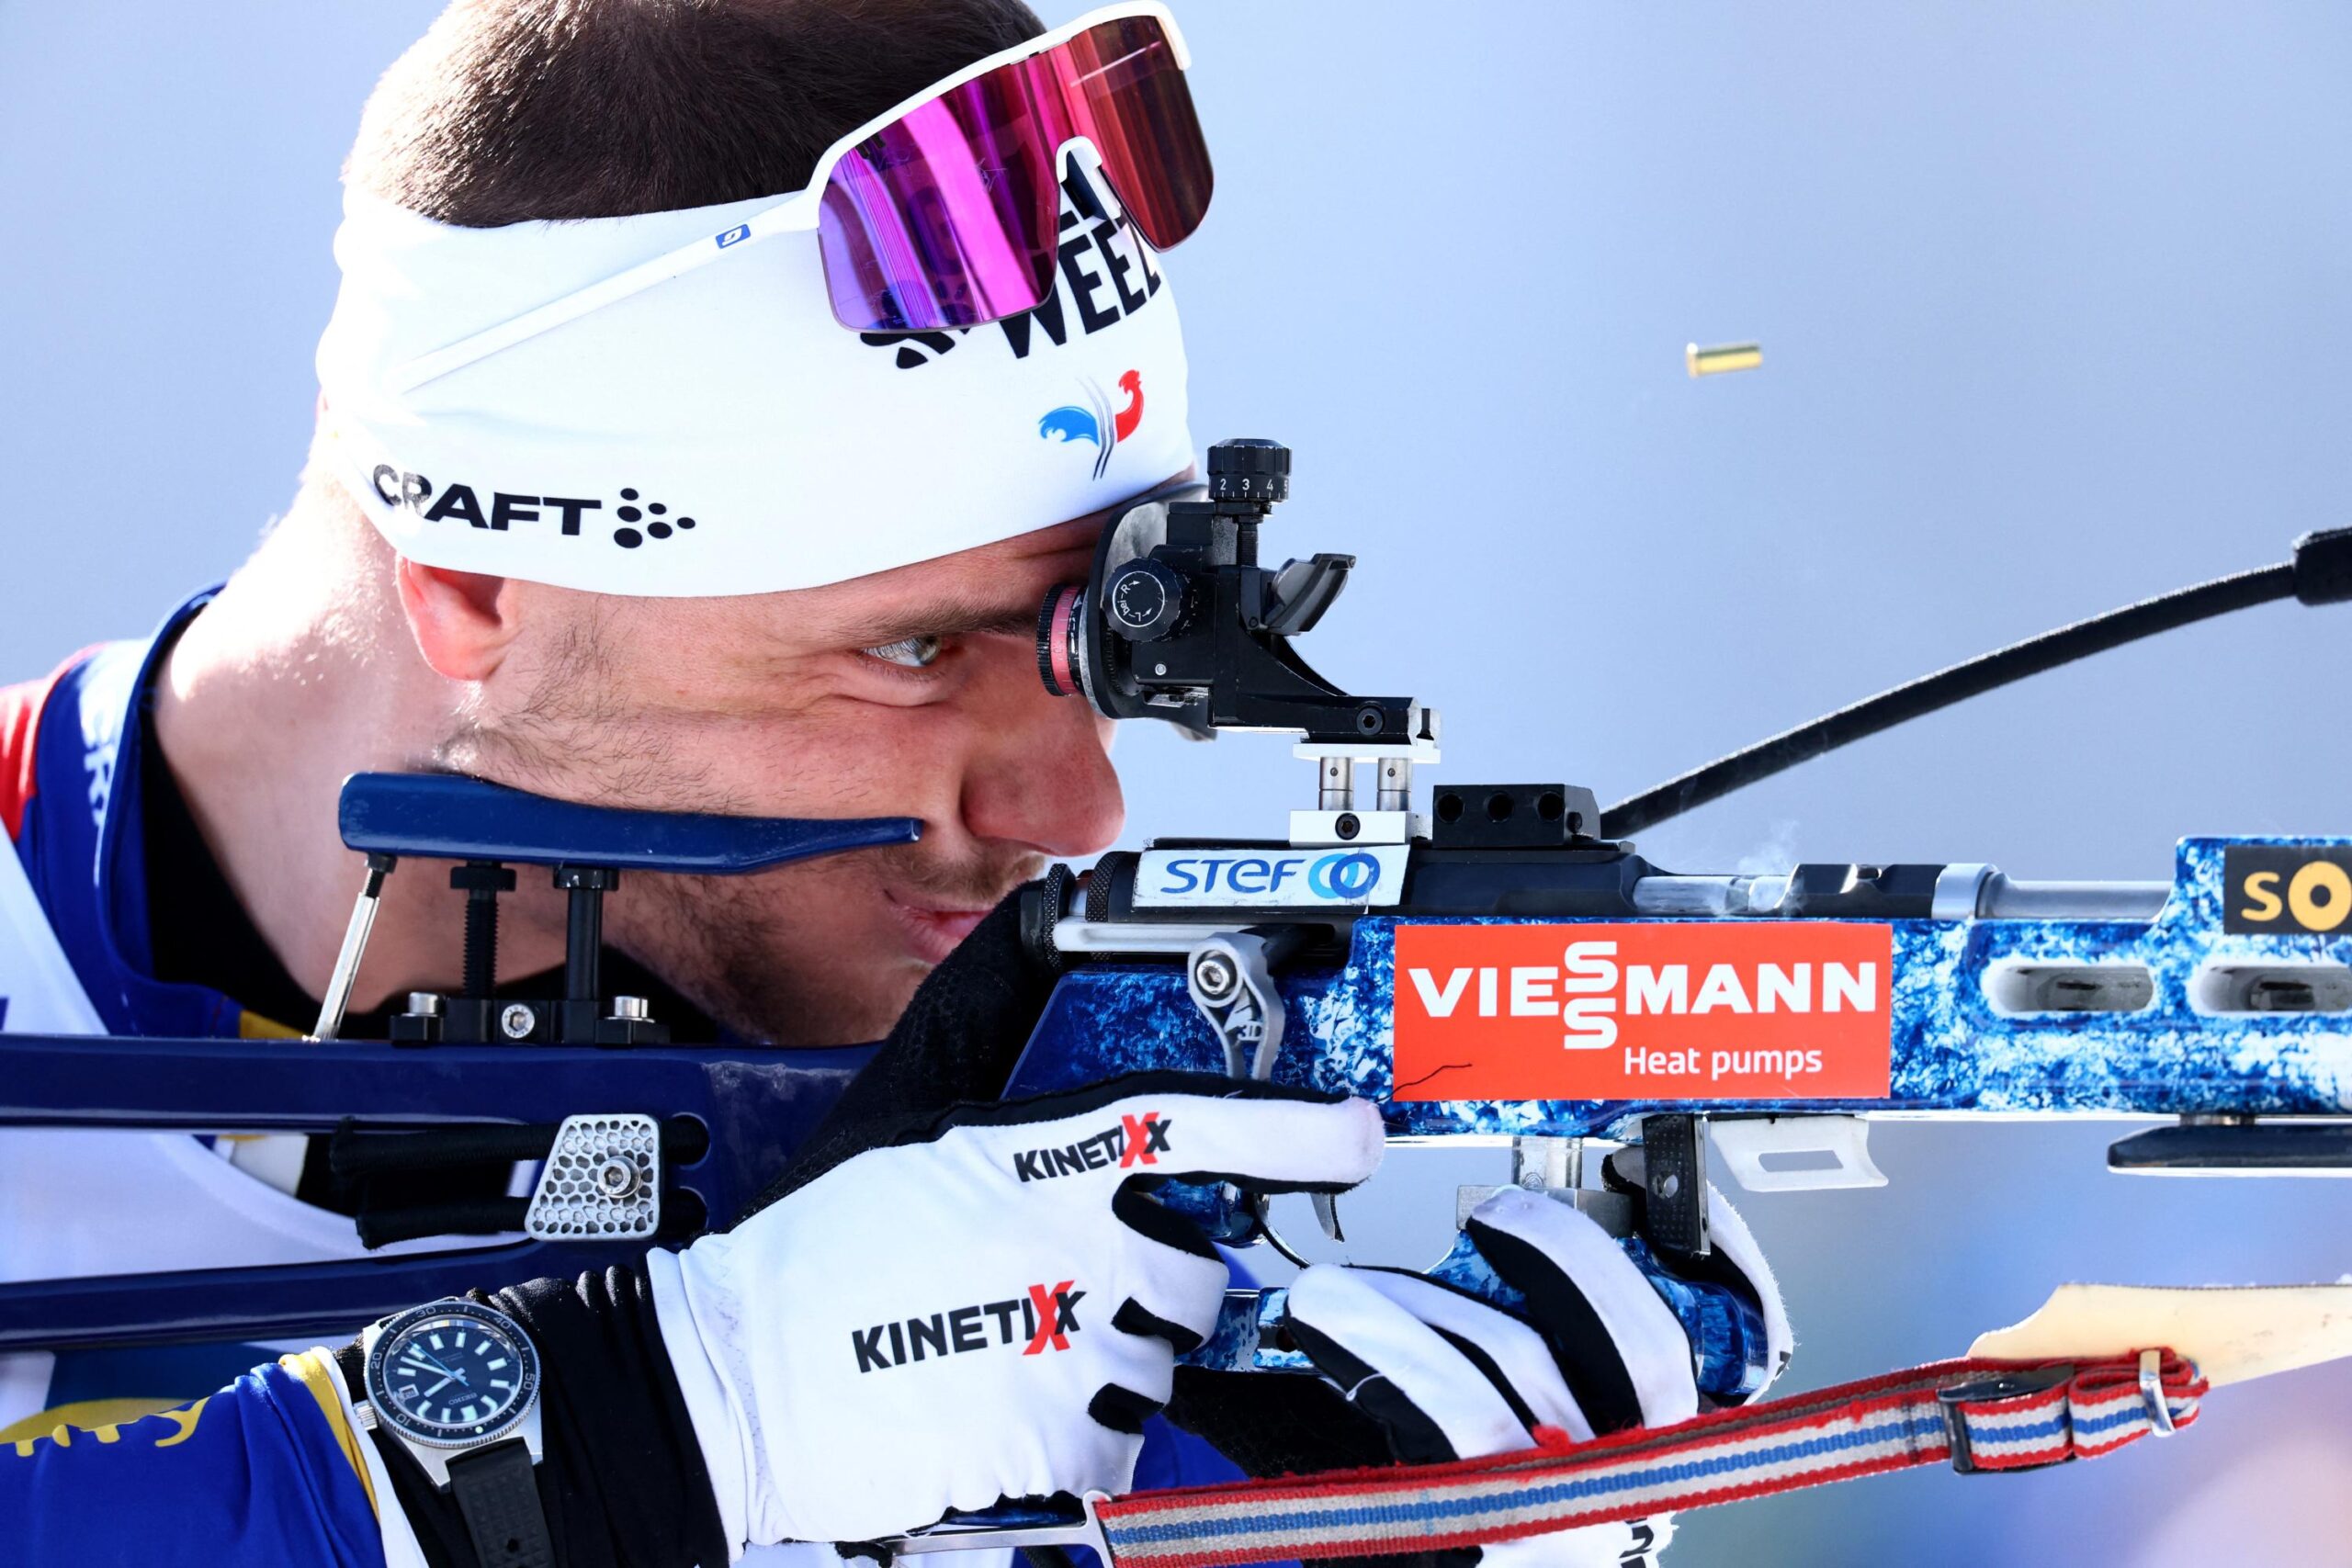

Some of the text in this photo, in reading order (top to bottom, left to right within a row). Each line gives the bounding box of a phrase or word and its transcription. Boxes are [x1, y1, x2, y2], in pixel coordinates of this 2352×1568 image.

[1220, 478, 1227, 491] 2
[1242, 478, 1250, 491] 3
[1266, 479, 1273, 491] 4
[372, 463, 602, 536] CRAFT
[1408, 941, 1877, 1050] VIESSMANN
[1624, 1047, 1823, 1080] Heat pumps
[1013, 1112, 1172, 1182] KINETIXX
[415, 1306, 436, 1318] 30
[493, 1316, 512, 1330] 40
[853, 1280, 1087, 1373] KINETIXX
[370, 1352, 383, 1370] 20
[523, 1372, 536, 1390] 50
[395, 1413, 412, 1427] 10
